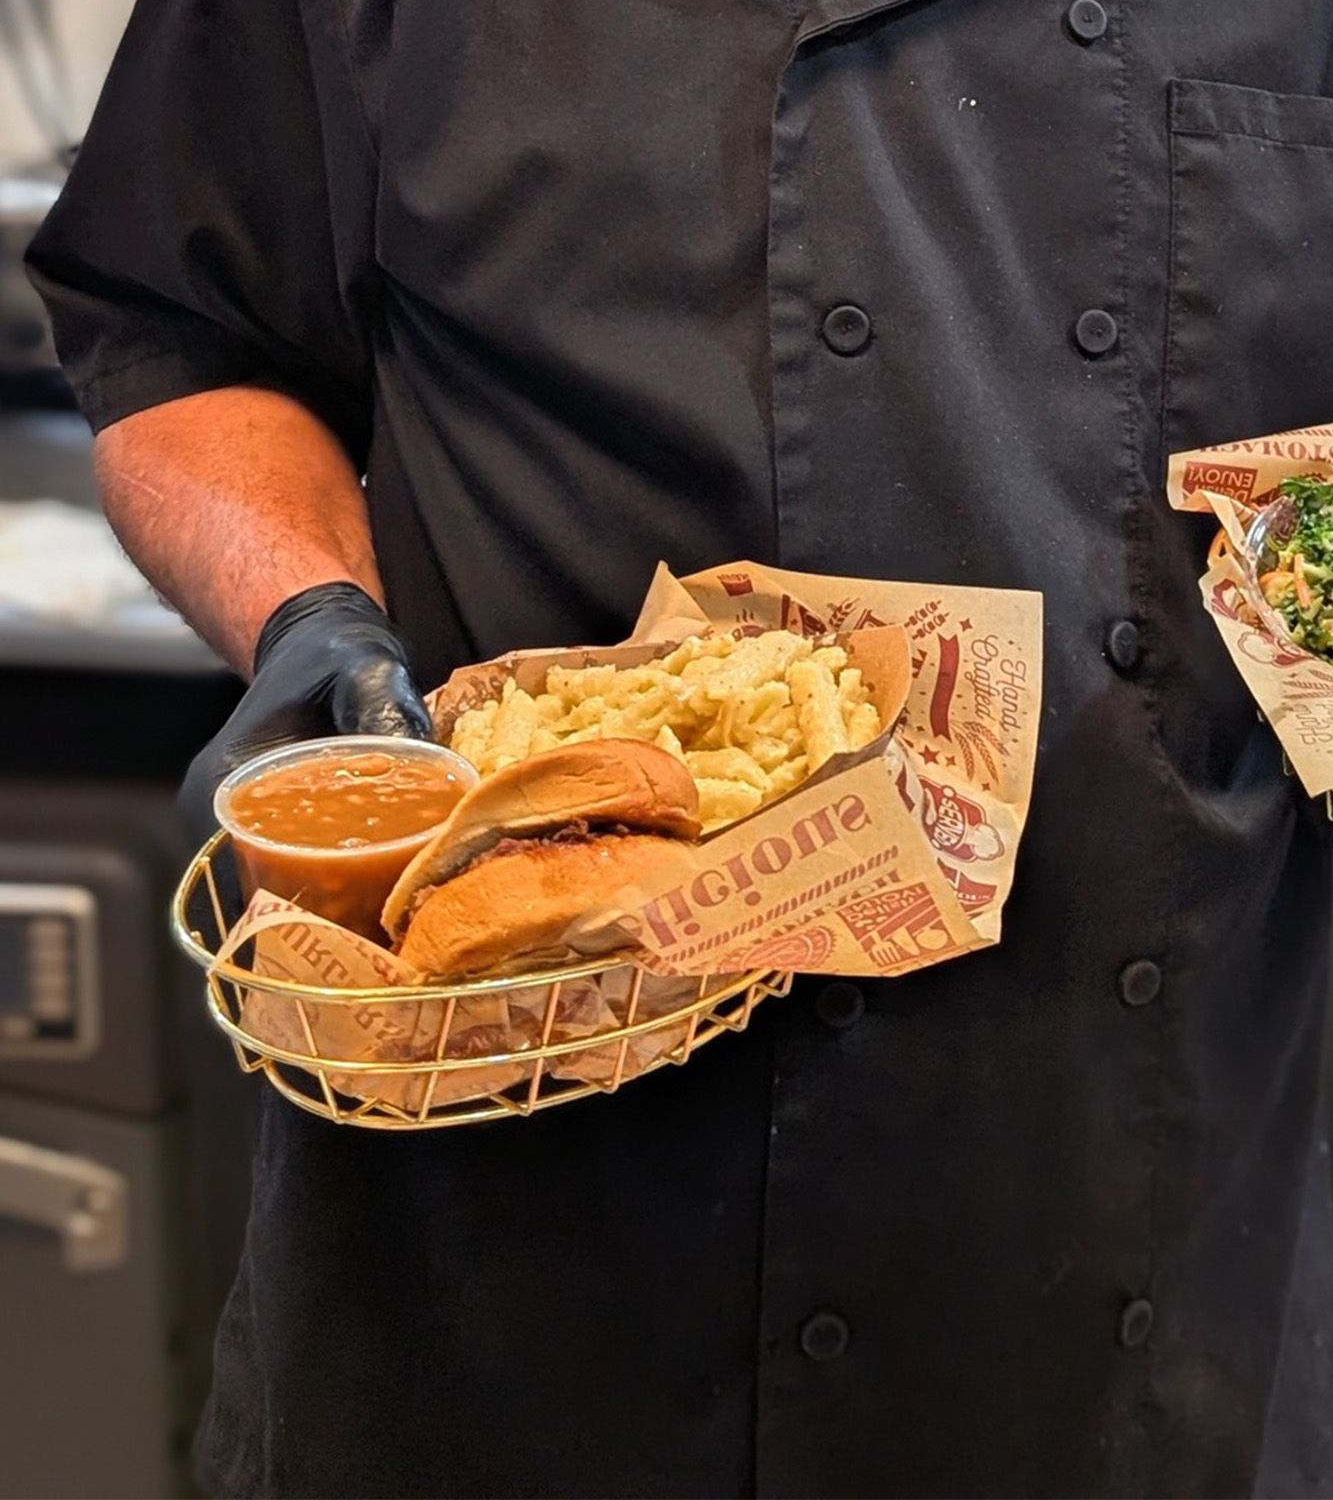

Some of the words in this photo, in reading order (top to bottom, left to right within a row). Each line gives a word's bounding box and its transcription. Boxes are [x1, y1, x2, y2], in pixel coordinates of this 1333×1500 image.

[1187, 464, 1255, 487] ENJOY!
[963, 633, 1000, 724] Crafted
[999, 658, 1028, 733] Hand
